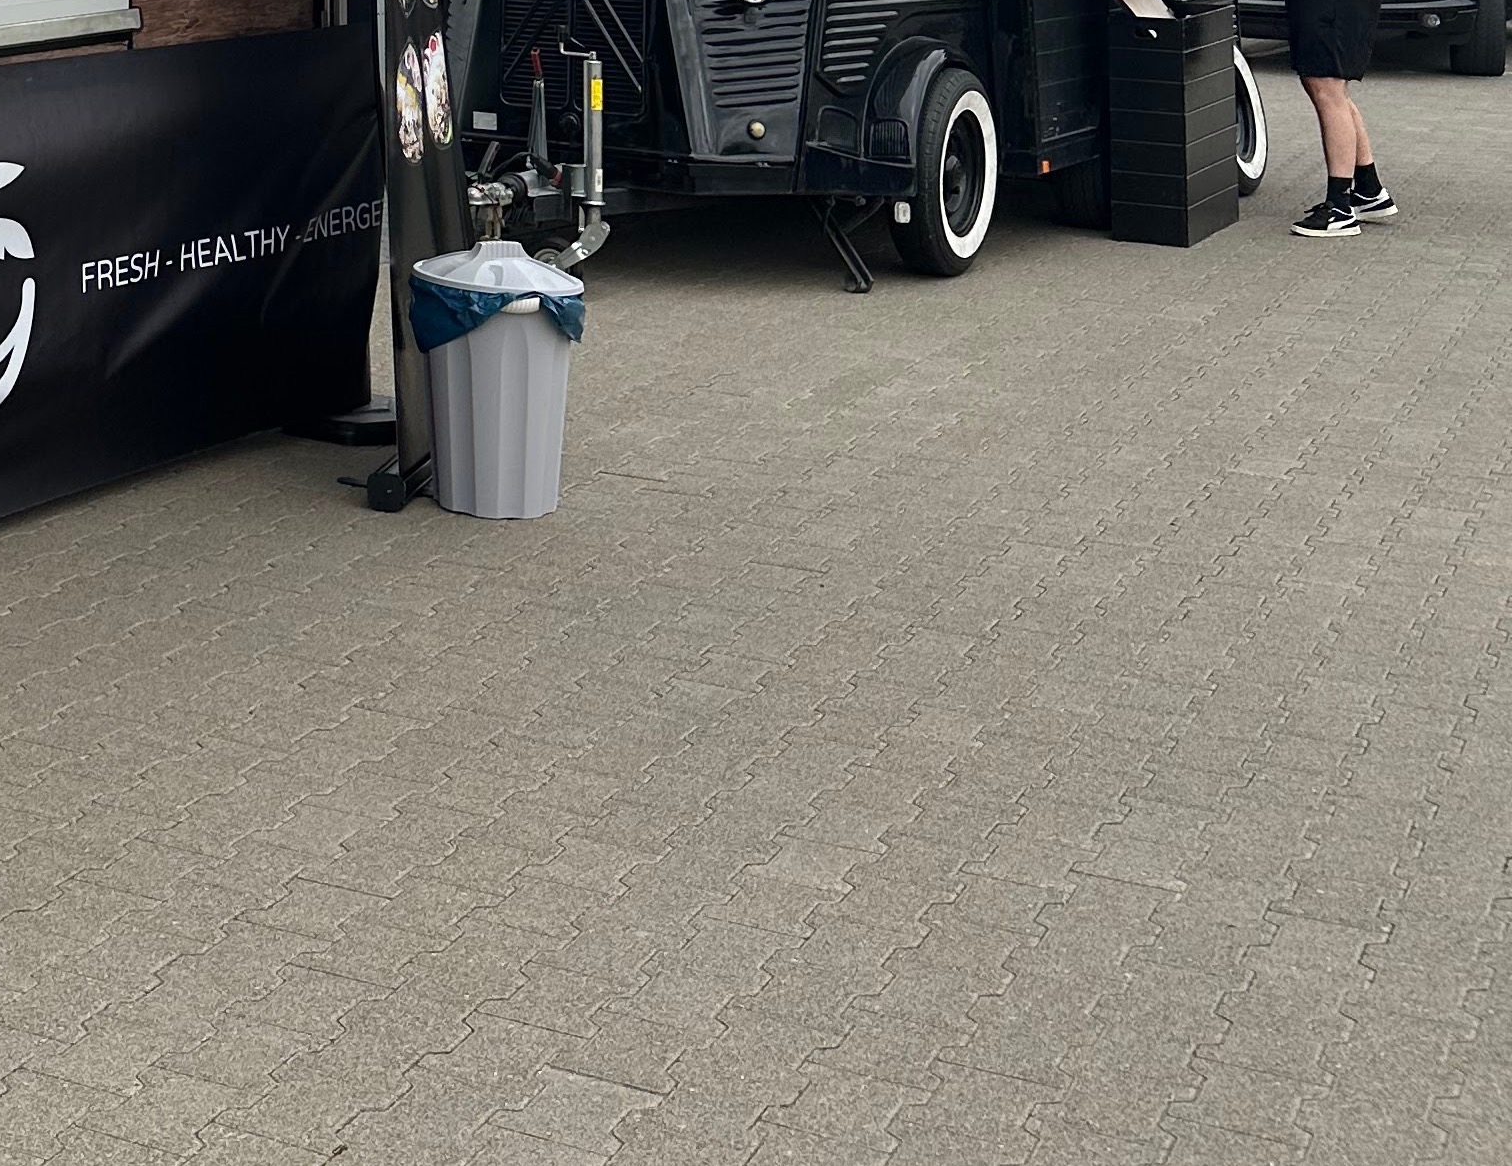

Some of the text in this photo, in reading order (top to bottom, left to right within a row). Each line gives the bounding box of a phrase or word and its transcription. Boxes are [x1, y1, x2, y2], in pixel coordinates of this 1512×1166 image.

[82, 249, 160, 294] FRESH
[180, 225, 290, 272] HEALTHY
[303, 198, 385, 243] ENERGE
